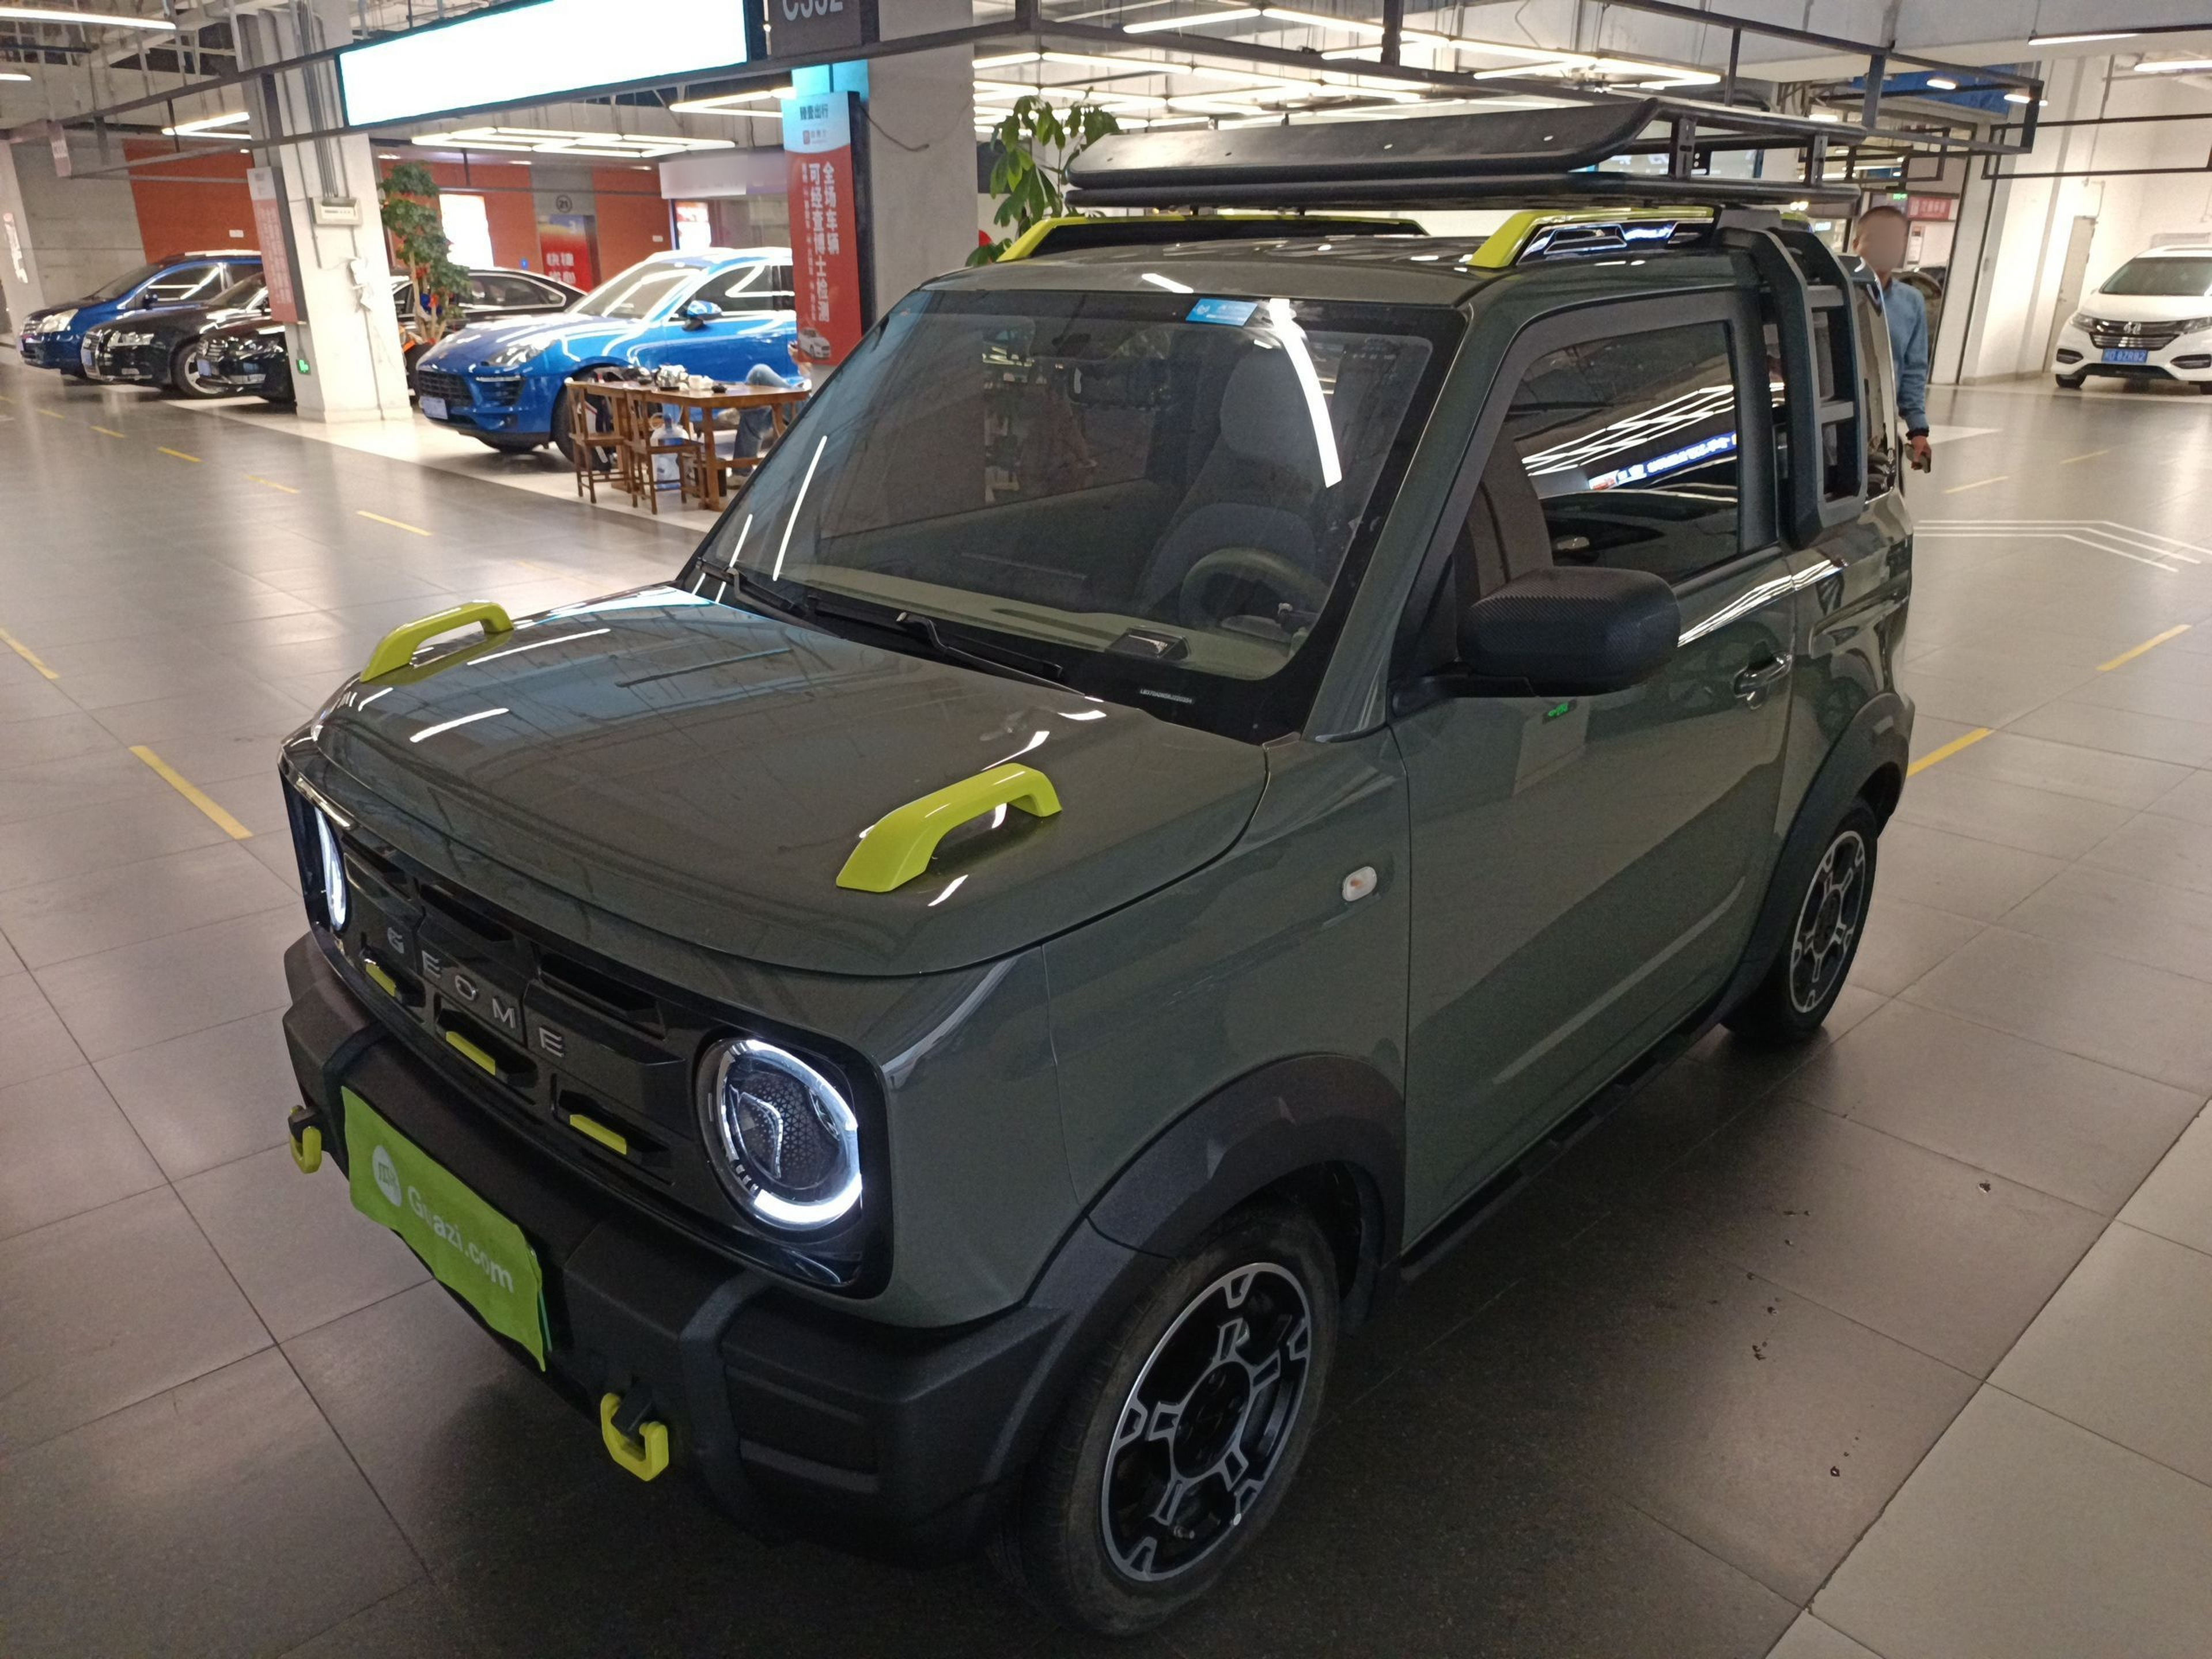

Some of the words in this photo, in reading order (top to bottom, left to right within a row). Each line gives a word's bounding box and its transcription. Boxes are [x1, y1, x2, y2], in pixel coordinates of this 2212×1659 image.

[809, 163, 830, 322] 可经查博士检测
[823, 161, 839, 255] 全场车辆
[387, 926, 566, 1059] GEOME
[407, 1185, 515, 1294] Guazi.com
